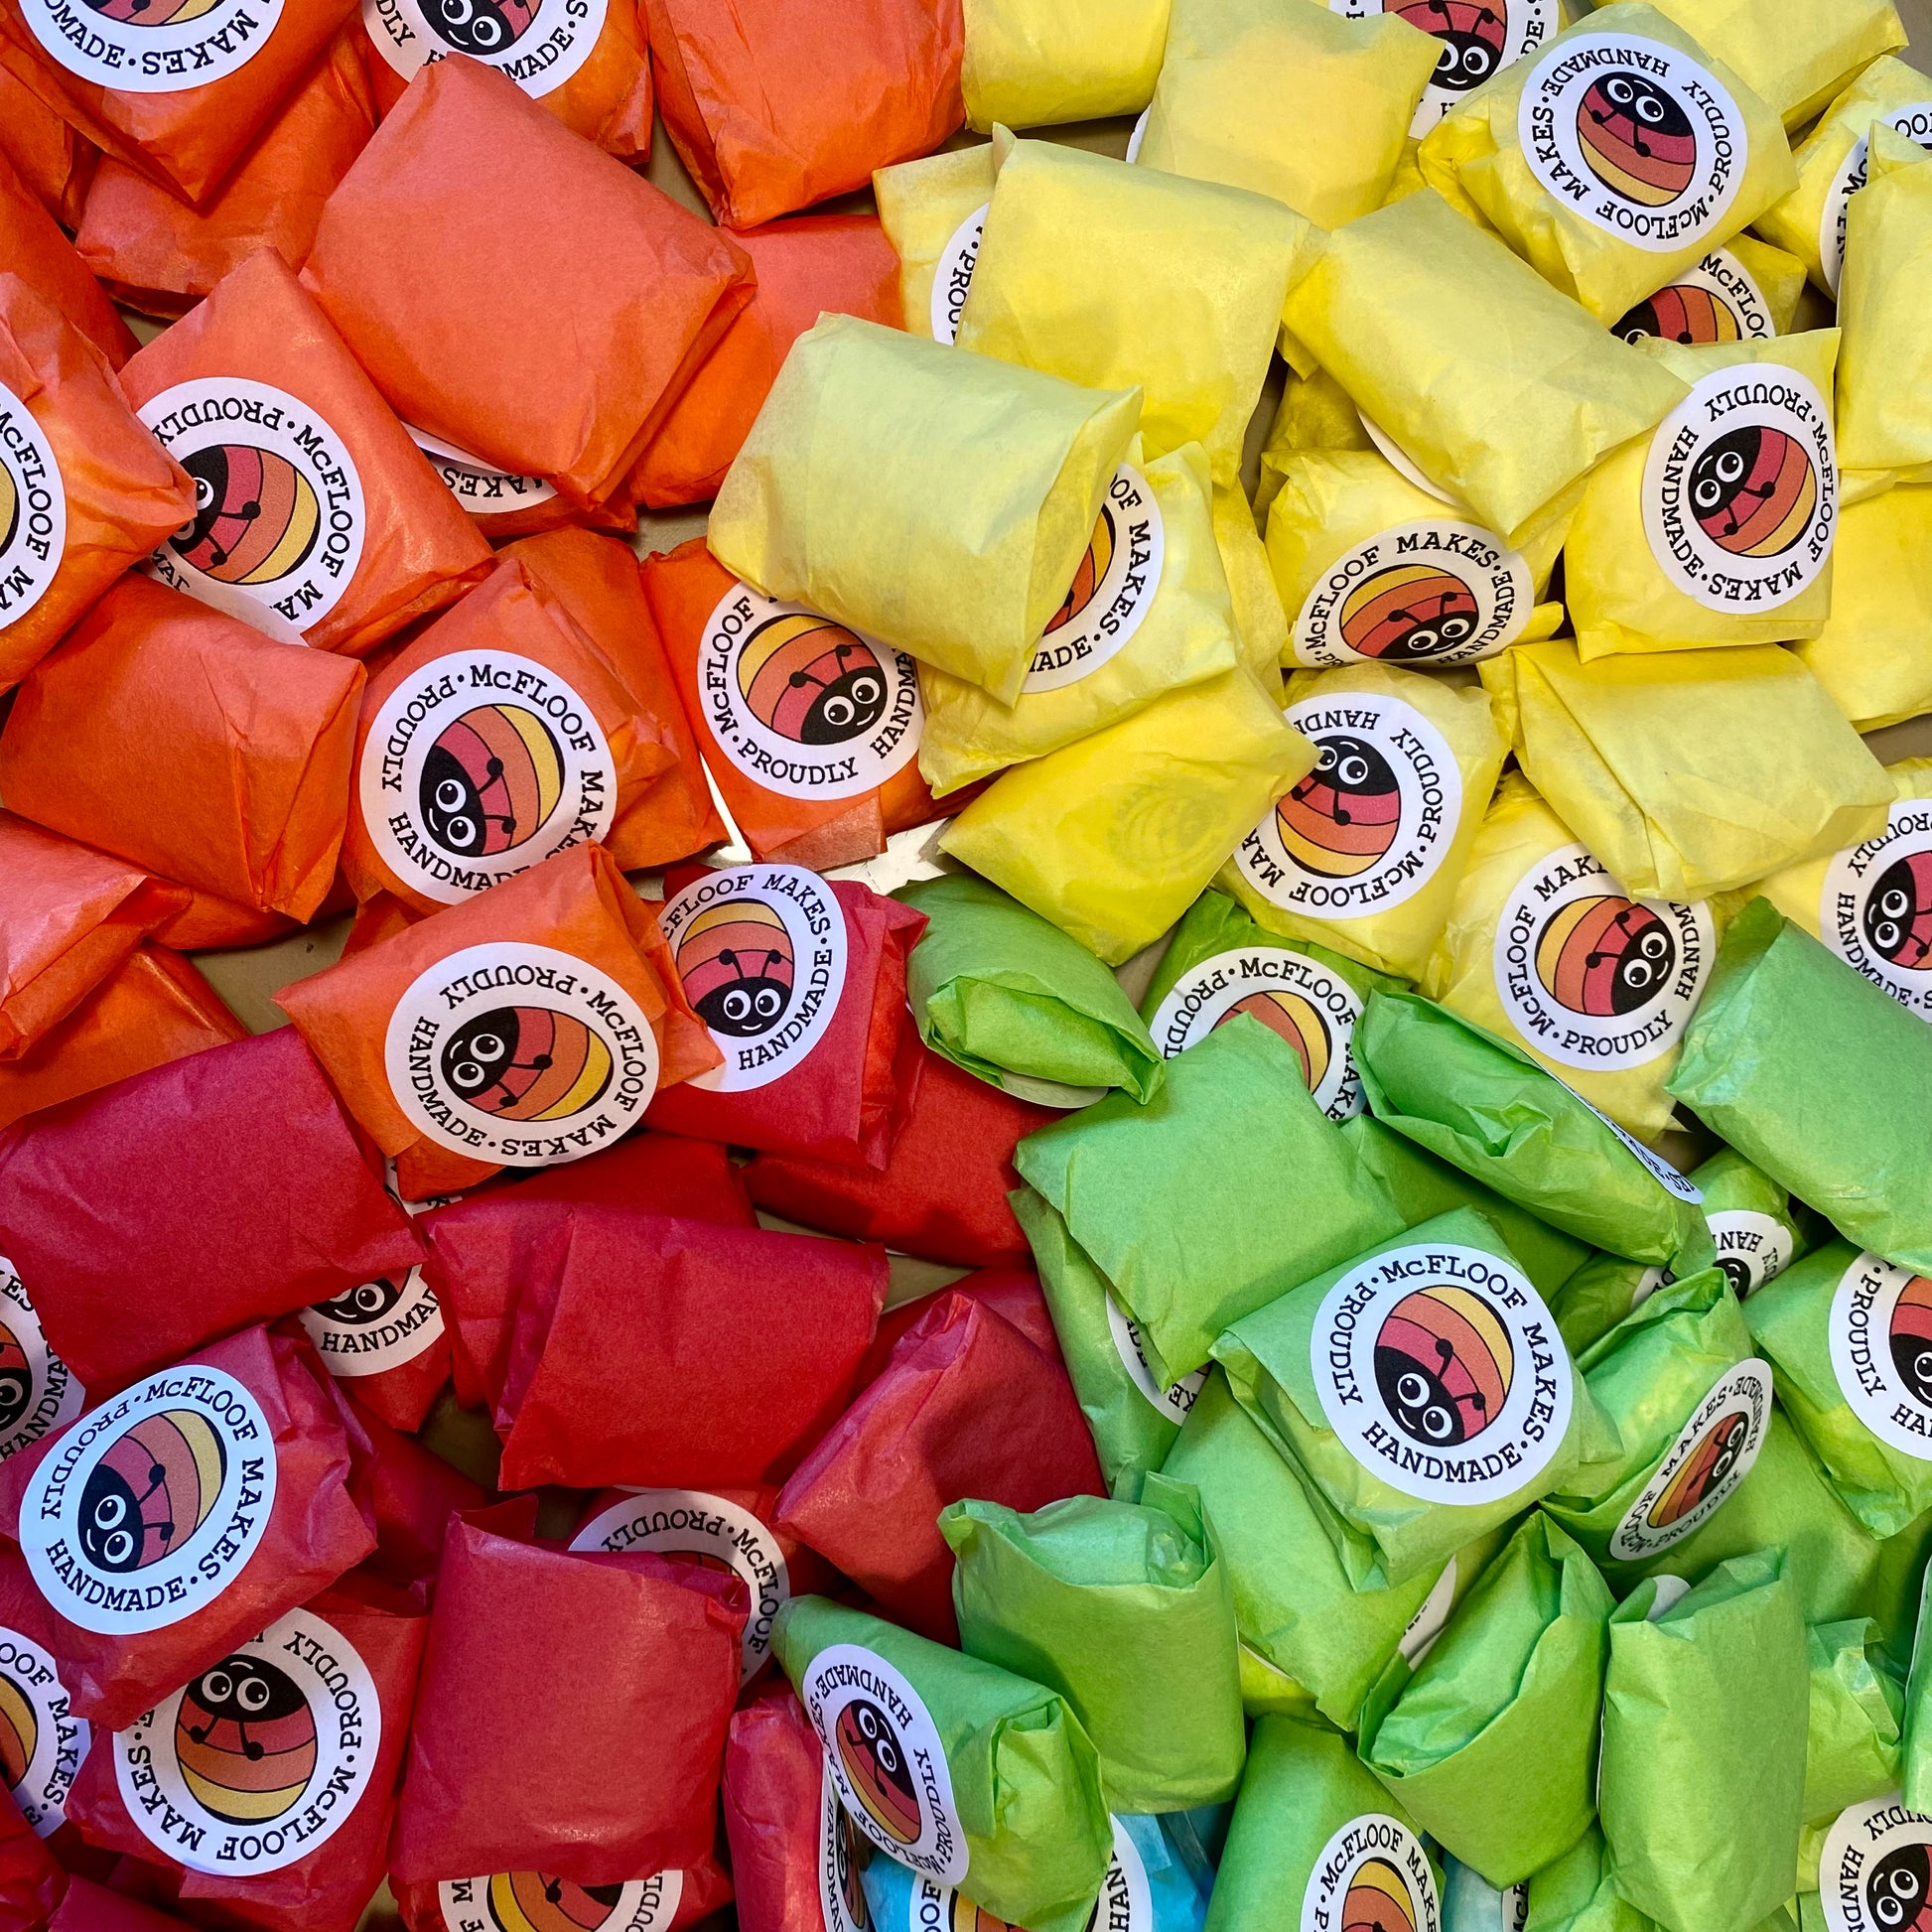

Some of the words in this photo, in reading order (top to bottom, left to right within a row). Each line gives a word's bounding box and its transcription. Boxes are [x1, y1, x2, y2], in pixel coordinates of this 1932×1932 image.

[43, 0, 125, 69] MADE
[142, 9, 258, 74] MAKES
[1541, 49, 1670, 96] HANDMADE
[1532, 106, 1590, 201] MAKES
[1682, 80, 1732, 196] PROUDLY
[1595, 197, 1709, 239] McFLOOF
[152, 398, 284, 447] PROUDLY
[1705, 383, 1812, 422] PROUDLY
[293, 425, 352, 578] McFLOOF
[443, 466, 544, 498] AKES
[1662, 425, 1705, 578] HANDMADE
[1808, 422, 1835, 562] McFLOOF
[1100, 520, 1151, 635] MAKES
[1306, 546, 1379, 649] McFLOOF
[1397, 532, 1500, 567] MAKES
[1436, 571, 1515, 664] HANDMADE
[1709, 561, 1803, 601] MAKES
[471, 664, 596, 752] McFLOOF
[707, 596, 754, 735] McFLOOF
[382, 675, 457, 792] PROUDLY
[738, 739, 858, 784] PROUDLY
[1390, 728, 1443, 843] PROUDLY
[762, 875, 830, 935] MAKES
[1289, 851, 1424, 906] McFLOOF
[440, 965, 578, 1010] PROUDLY
[739, 949, 832, 1070] HANDMADE
[1239, 957, 1357, 1026] McFLOOF
[1507, 904, 1555, 1035] McFLOOF
[586, 990, 647, 1112] McFLOOF
[1561, 1010, 1673, 1055] PROUDLY
[409, 1016, 487, 1147] HANDMADE
[501, 1114, 617, 1157] MAKES
[1330, 1282, 1376, 1405] PROUDLY
[1362, 1421, 1522, 1482] HANDMADE
[1379, 1255, 1528, 1310] McFLOOF
[1522, 1322, 1556, 1444] MAKES
[1849, 1274, 1886, 1397] PROUDLY
[145, 1377, 258, 1441] McFLOOF
[1661, 1386, 1726, 1476] MAKES
[42, 1400, 129, 1519] PROUDLY
[198, 1457, 263, 1581] MAKES
[602, 1509, 727, 1553] PROUDLY
[47, 1539, 187, 1611] HANDMADE
[732, 1528, 780, 1655] McFLOOF
[283, 1631, 361, 1749] PROUDLY
[816, 1664, 912, 1729] HANDMADE
[44, 1696, 78, 1805] MAKES
[128, 1745, 207, 1851] MAKES
[216, 1766, 356, 1861] McFLOOF
[913, 1748, 953, 1863] PROUDLY
[1320, 1824, 1403, 1895] McFLOOF
